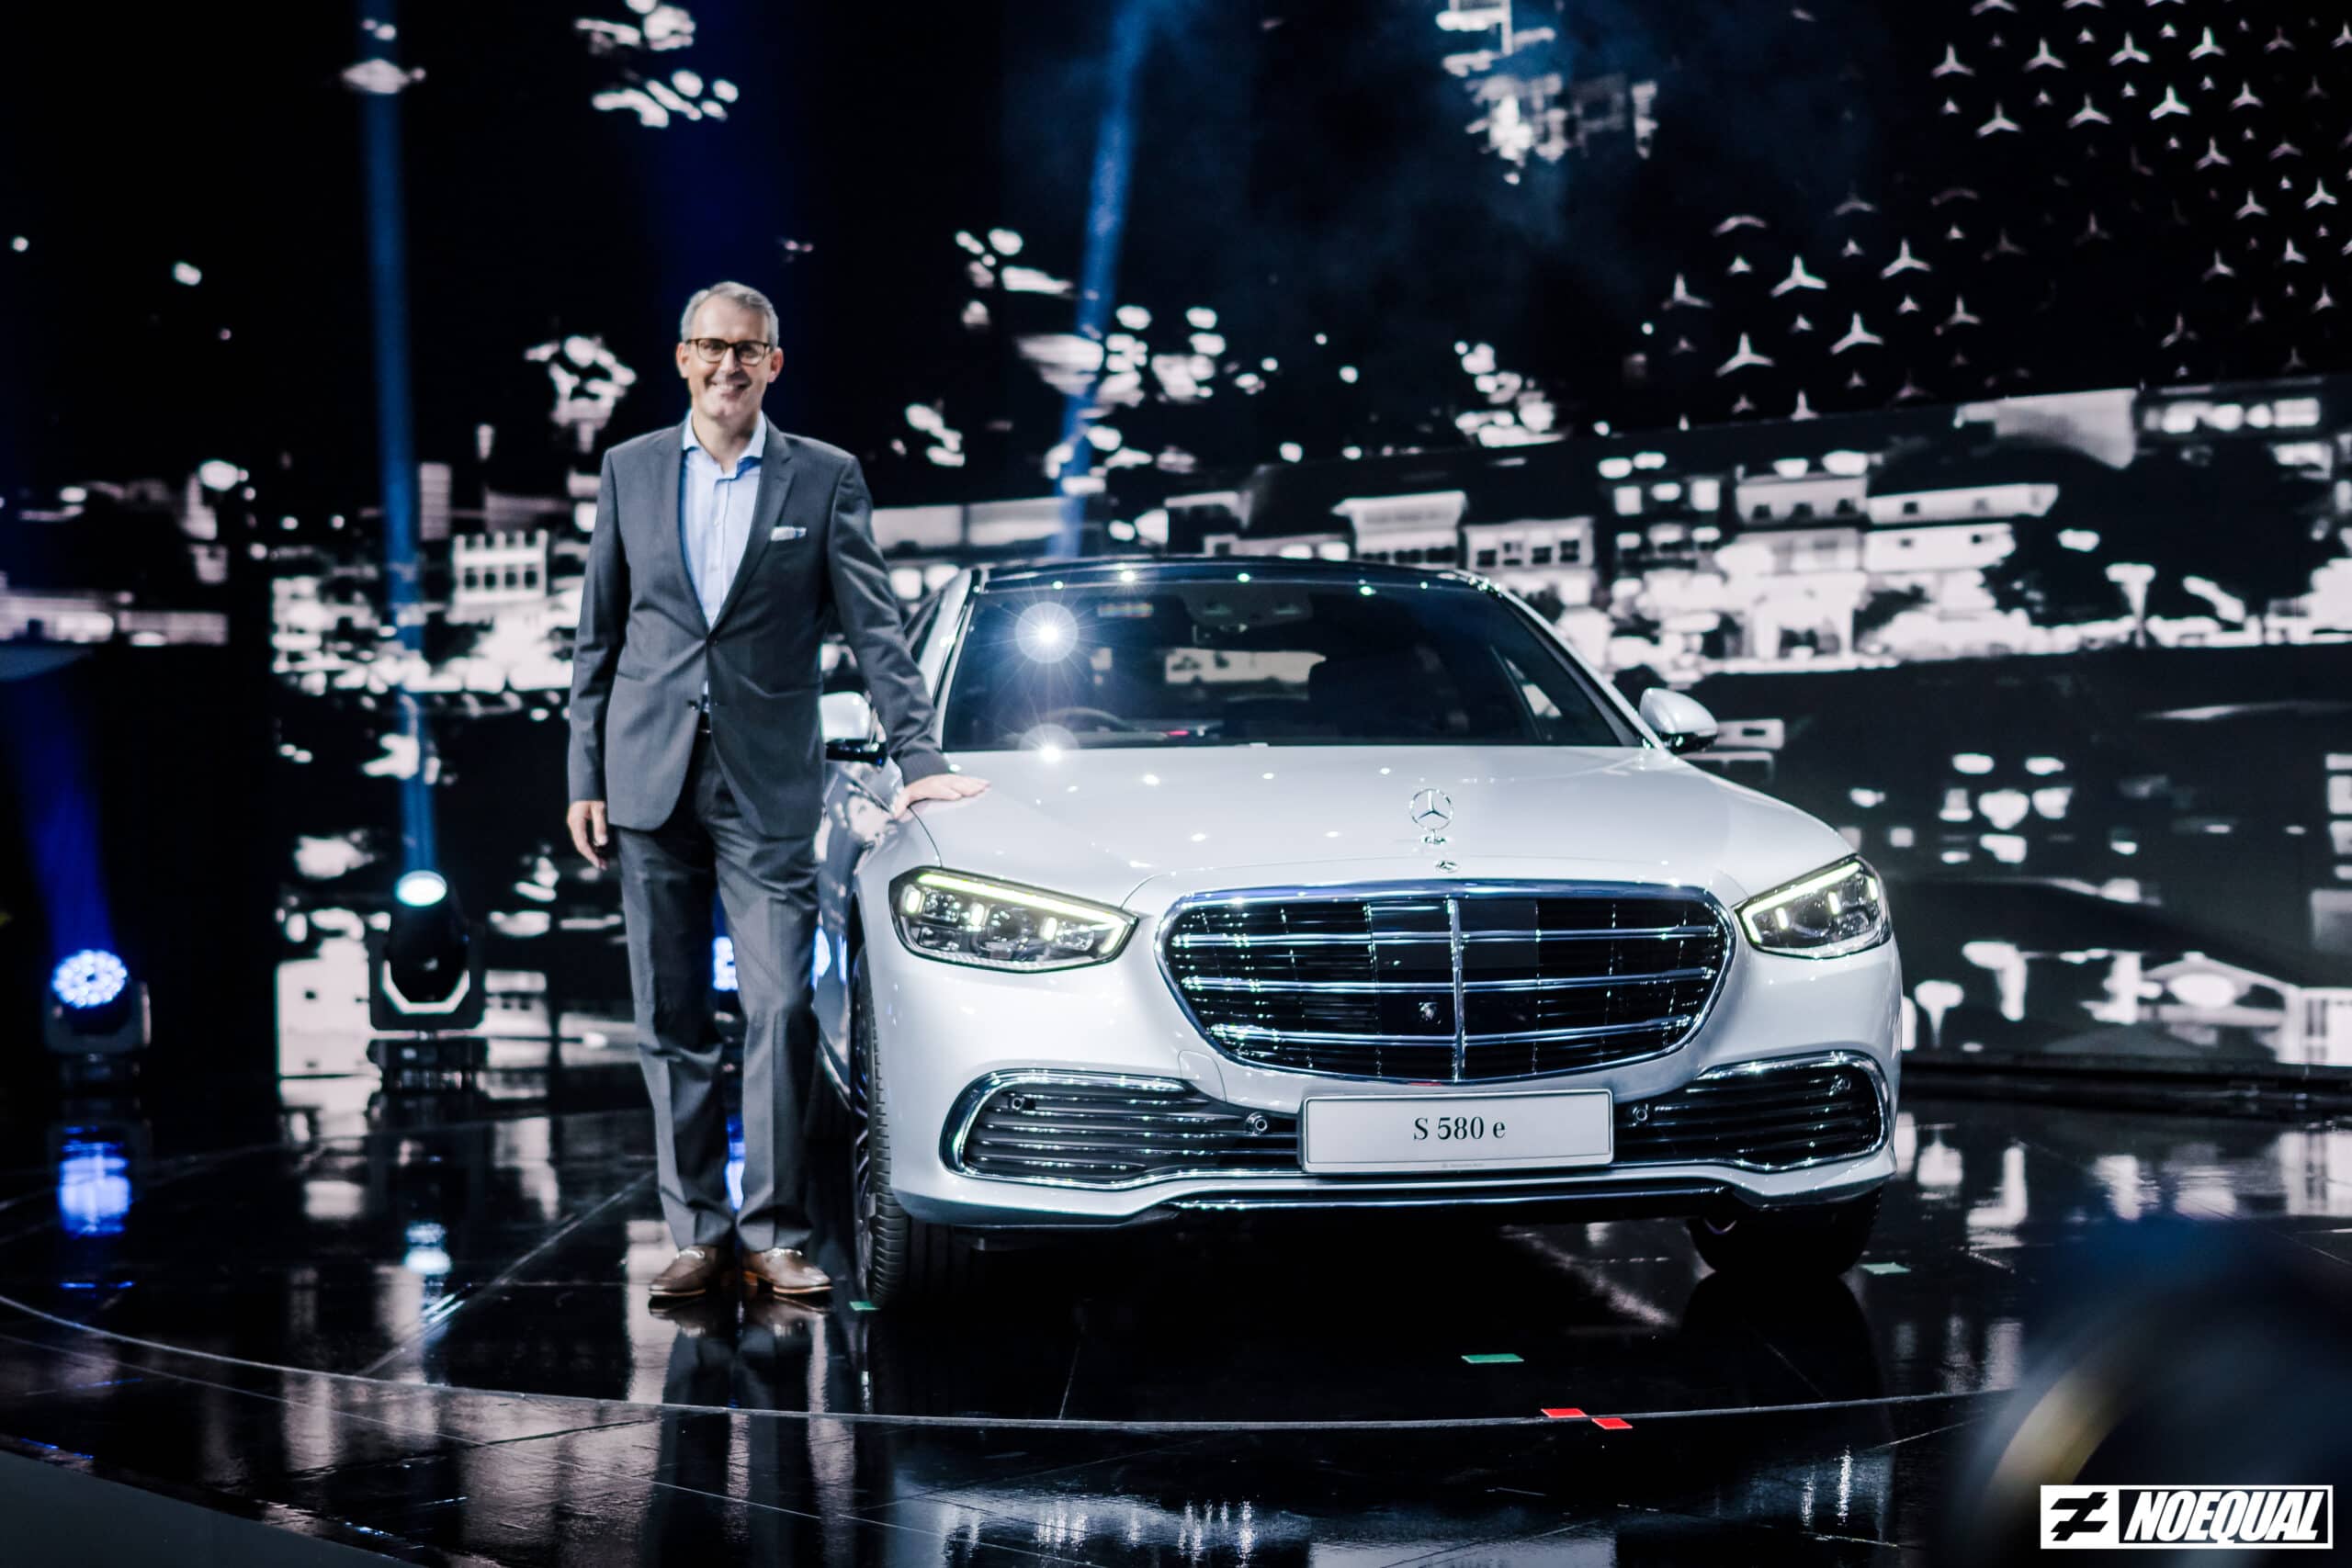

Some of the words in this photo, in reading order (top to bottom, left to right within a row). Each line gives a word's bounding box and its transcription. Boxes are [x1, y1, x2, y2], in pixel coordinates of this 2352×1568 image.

[1413, 1117, 1429, 1140] S
[1437, 1116, 1485, 1140] 580
[1492, 1121, 1507, 1139] e
